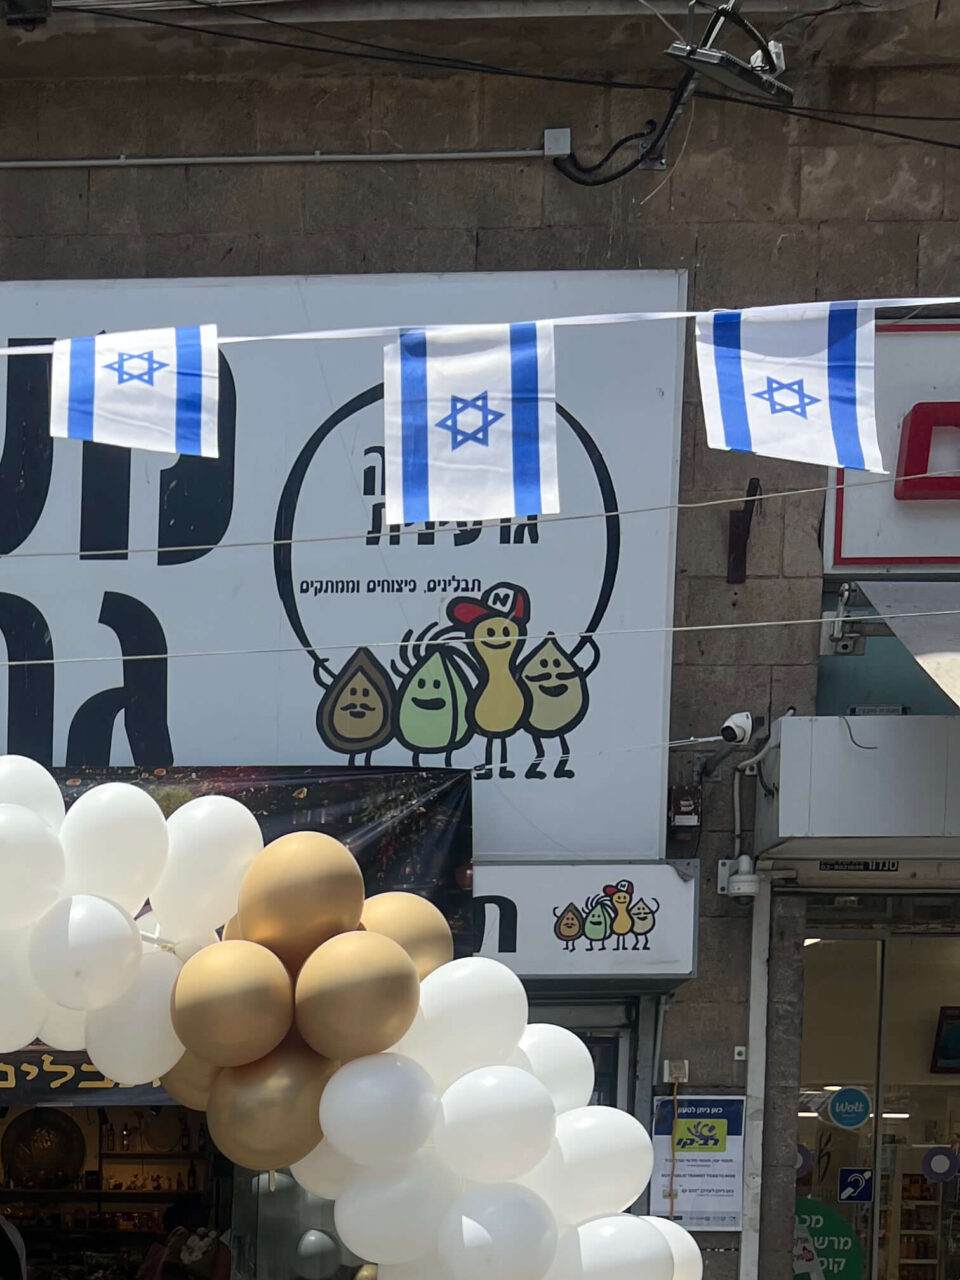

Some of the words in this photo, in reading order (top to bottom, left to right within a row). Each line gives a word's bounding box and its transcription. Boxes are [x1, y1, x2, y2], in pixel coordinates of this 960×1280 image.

[299, 579, 360, 597] וממתקים
[367, 577, 417, 593] פיצוחים
[835, 1101, 865, 1112] Wolt
[814, 1236, 852, 1250] מרש
